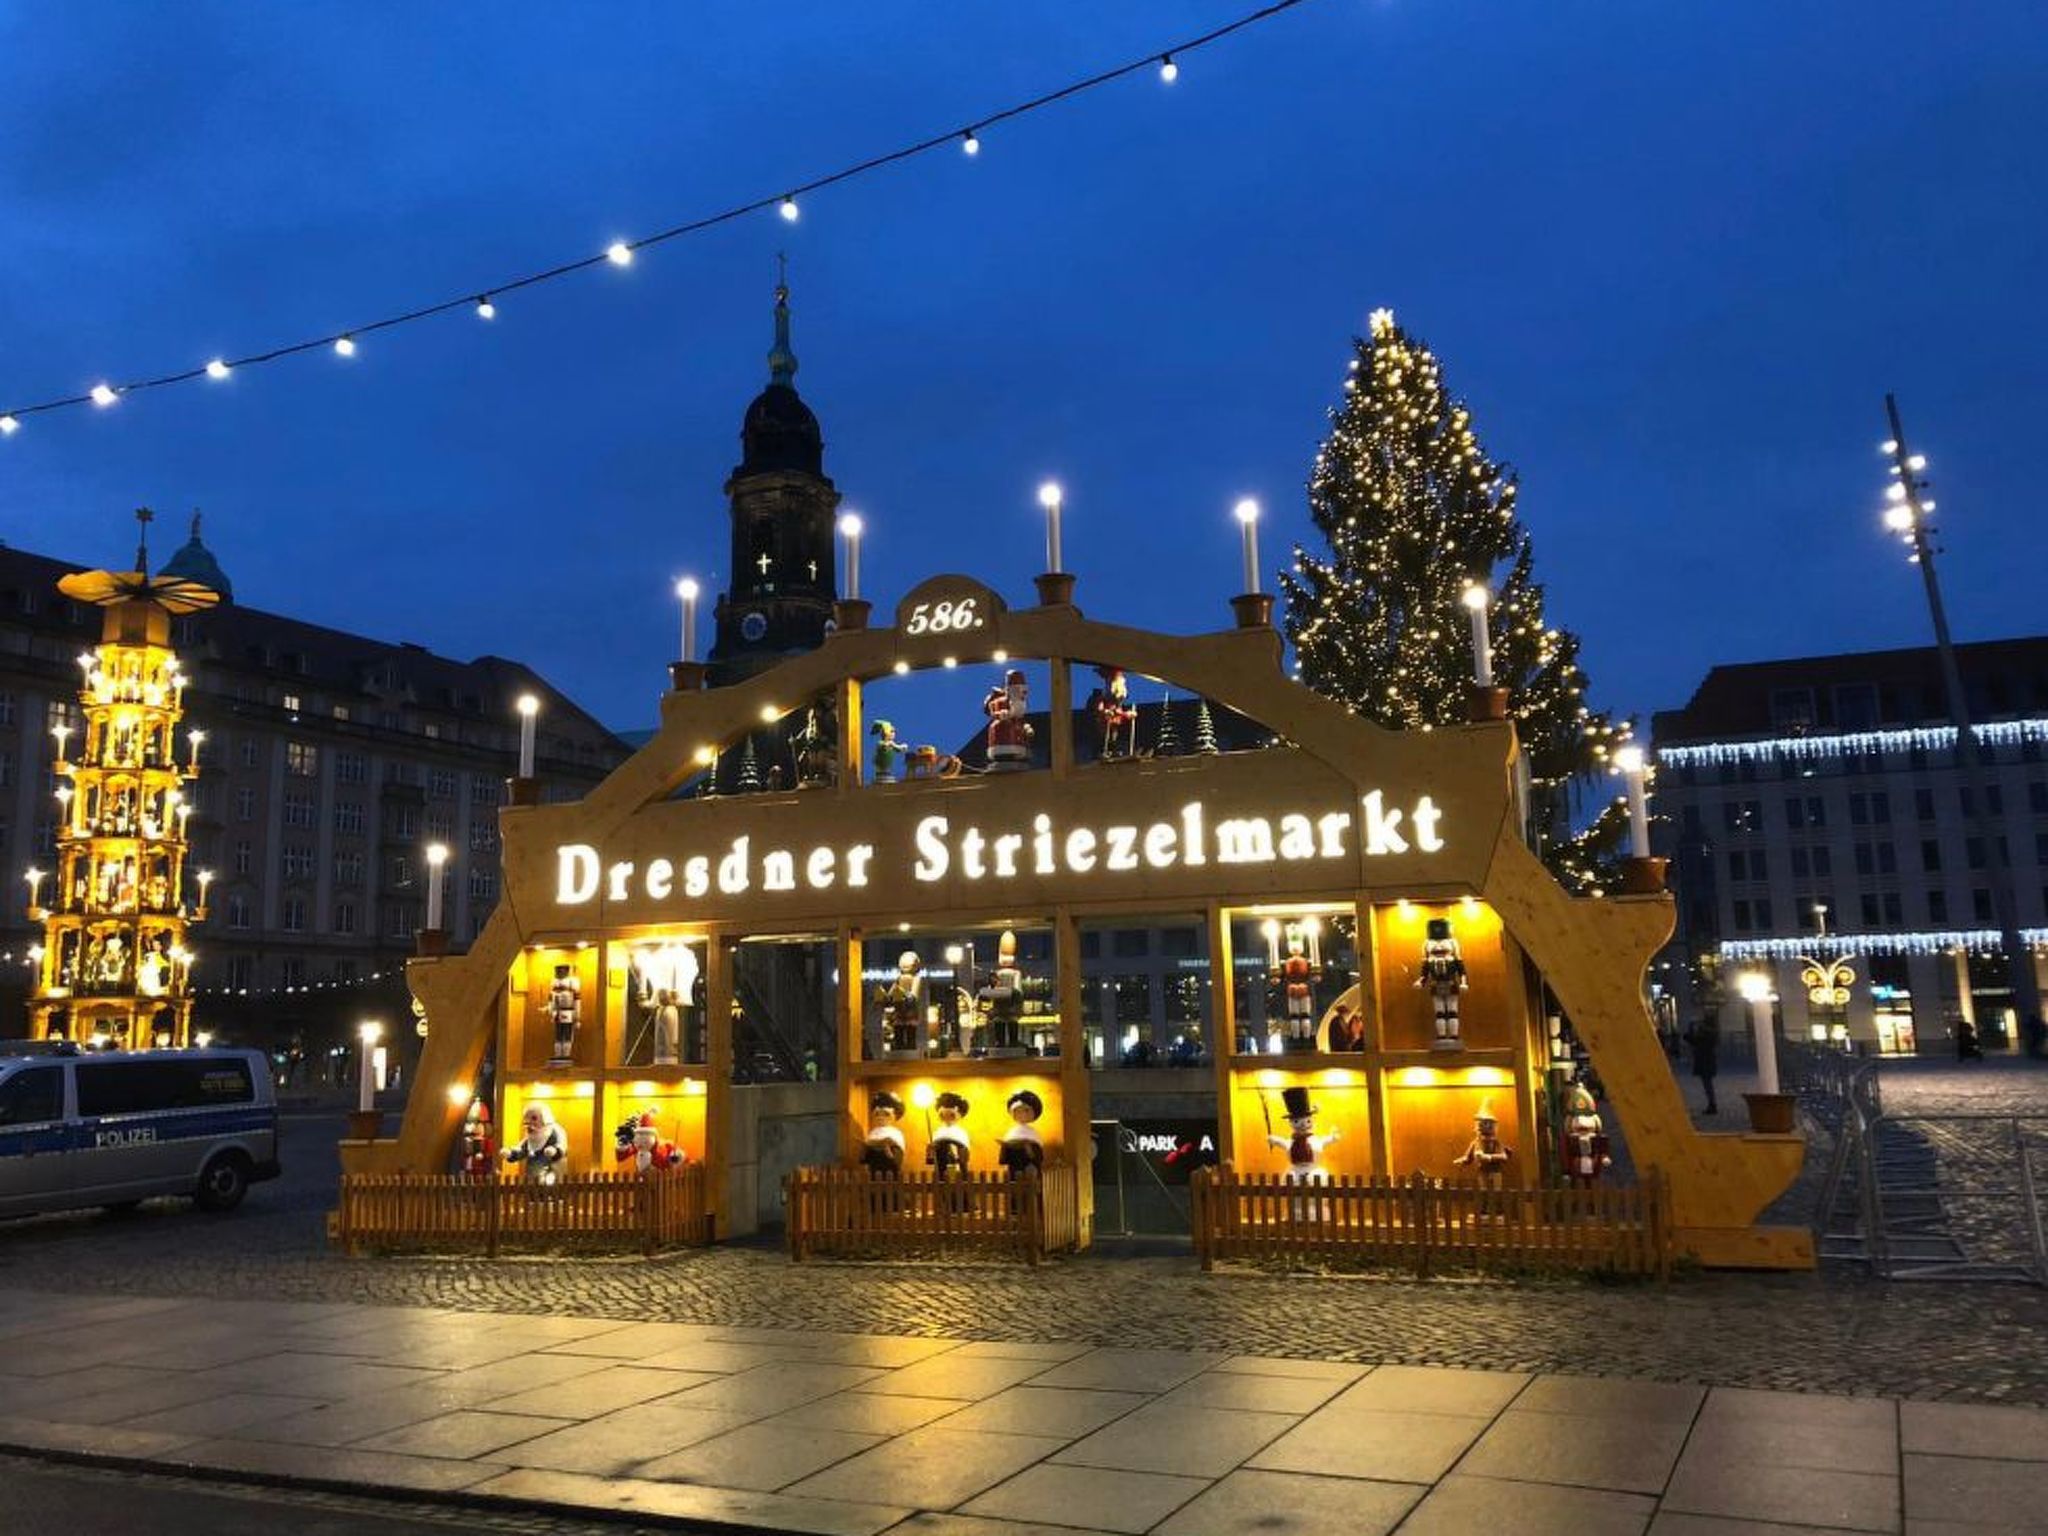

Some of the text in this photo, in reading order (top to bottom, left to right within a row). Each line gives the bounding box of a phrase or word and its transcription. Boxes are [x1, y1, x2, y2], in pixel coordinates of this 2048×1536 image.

[906, 598, 984, 635] 586.
[556, 789, 1445, 905] Dresdner Striezelmarkt
[95, 1127, 158, 1148] POLIZEI
[1138, 1134, 1178, 1152] PARK
[1199, 1135, 1214, 1151] A
